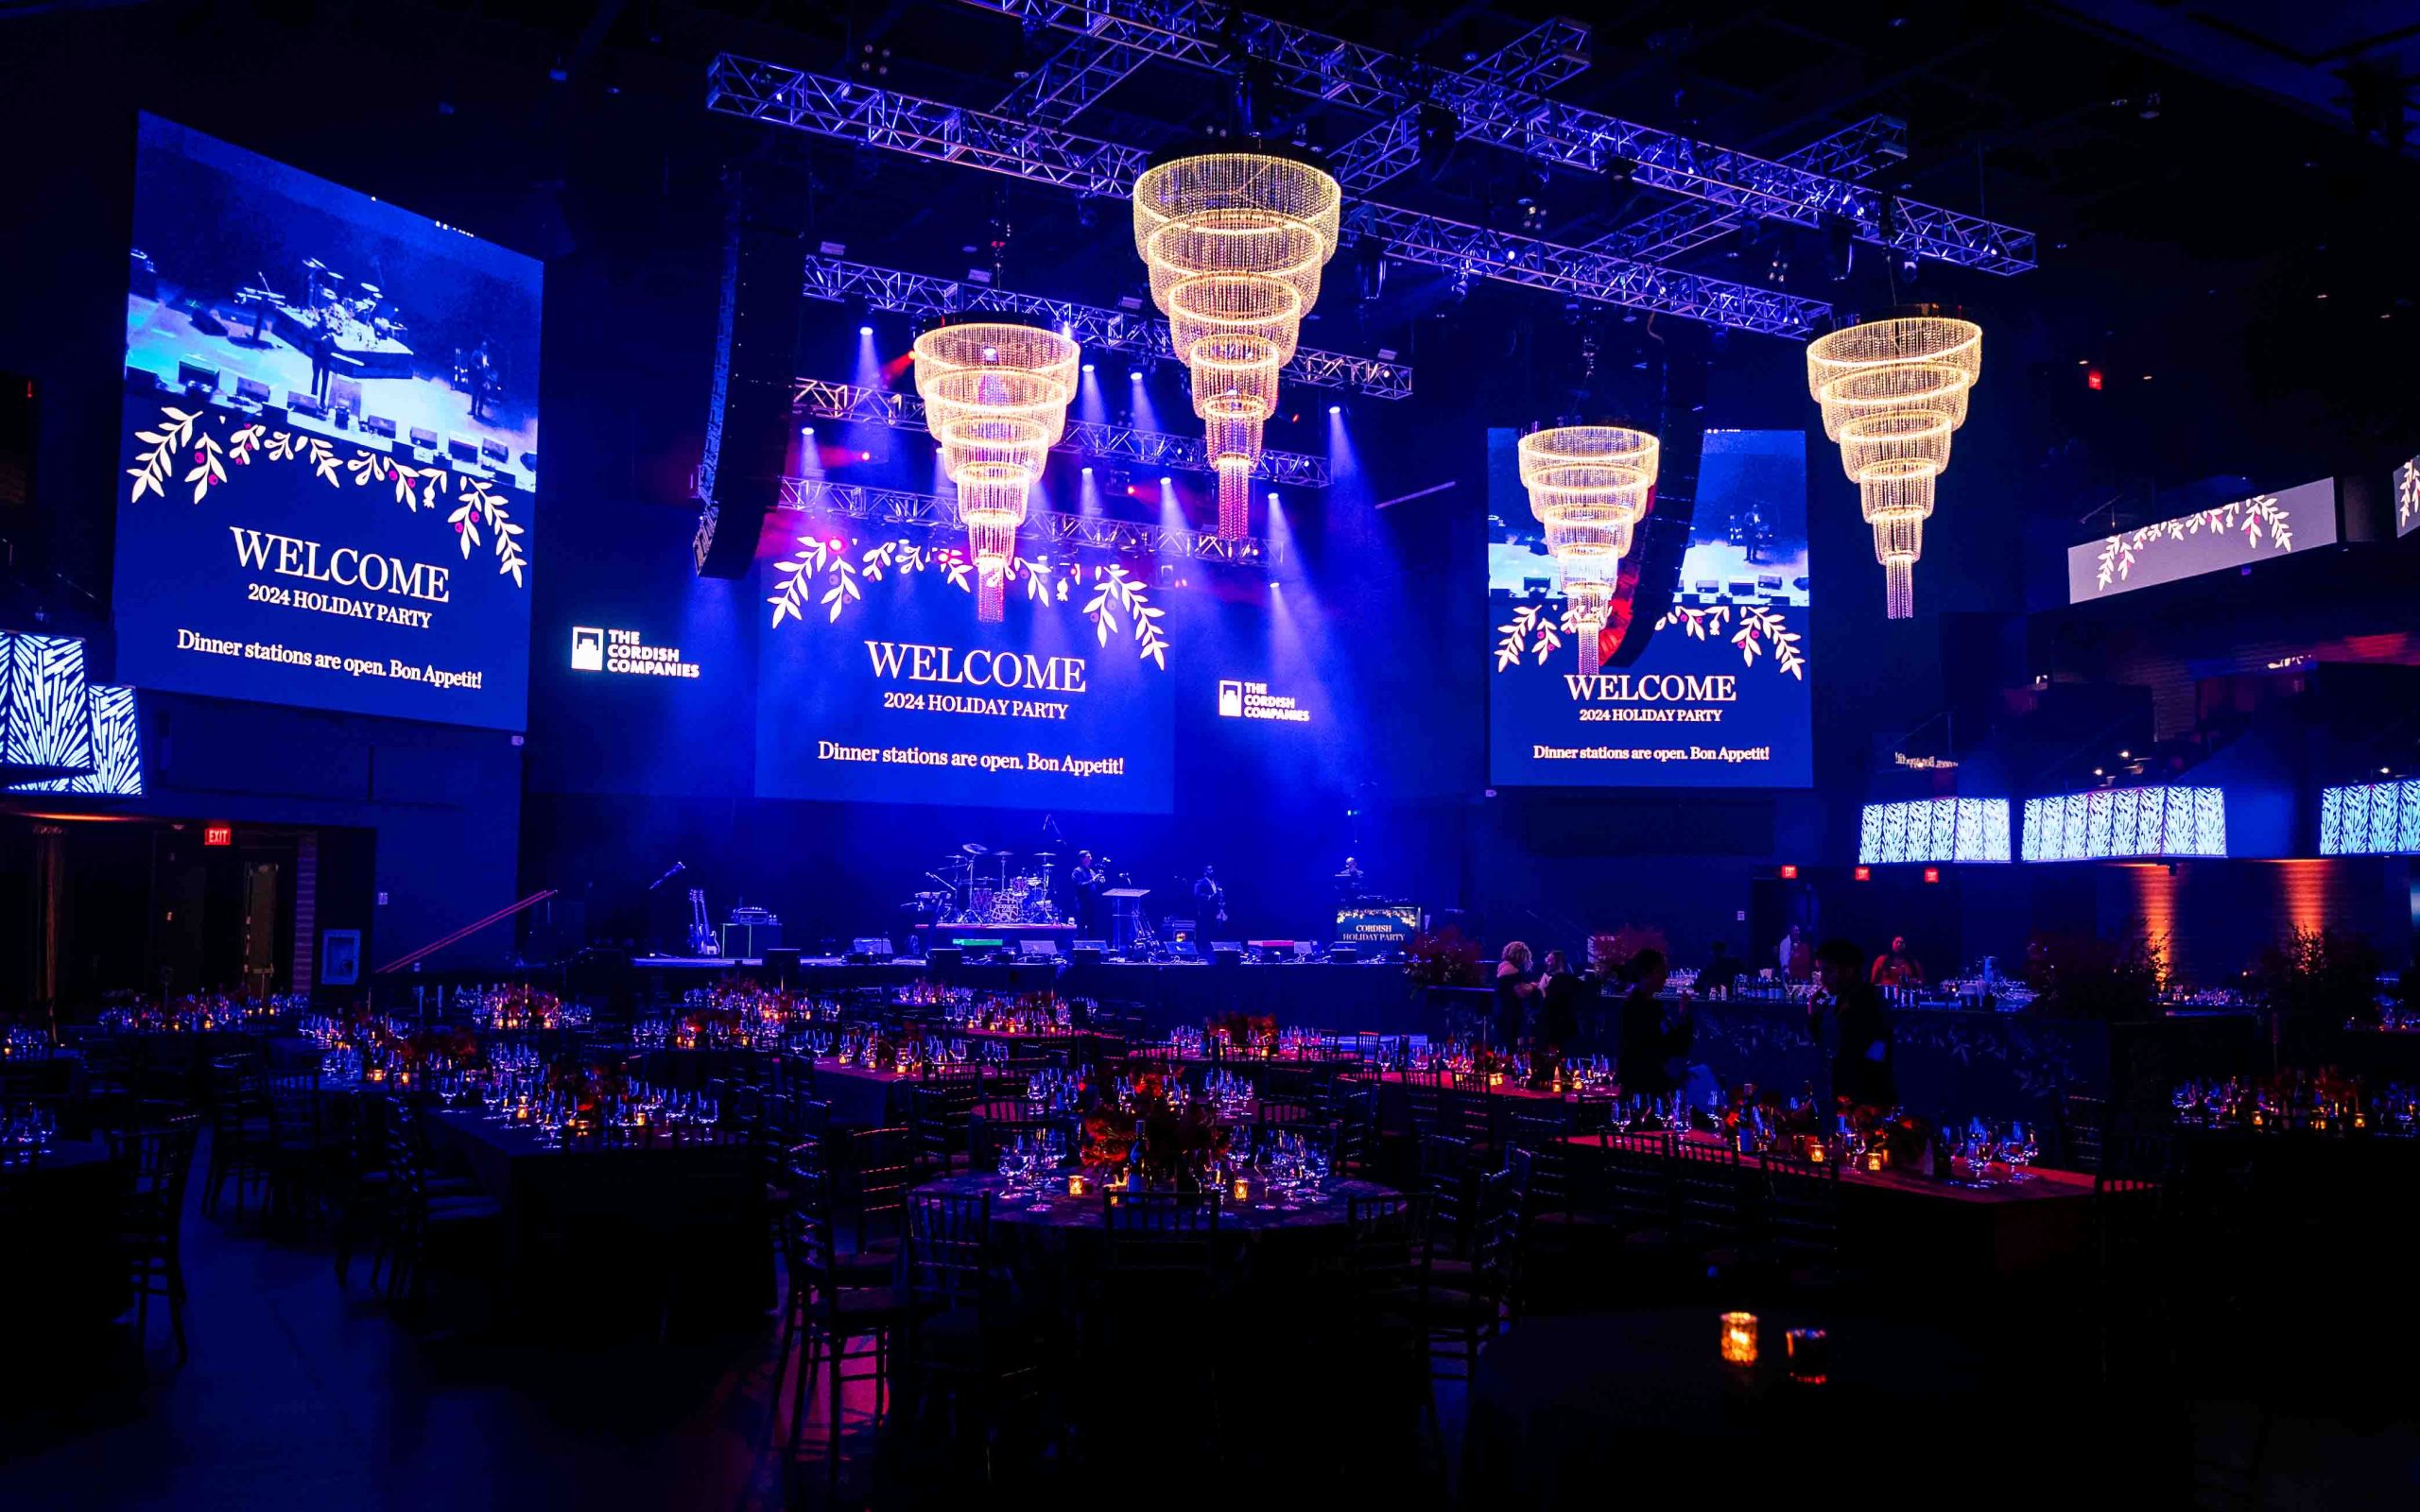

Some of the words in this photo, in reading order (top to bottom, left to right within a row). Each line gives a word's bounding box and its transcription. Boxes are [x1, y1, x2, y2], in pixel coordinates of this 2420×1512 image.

[229, 525, 450, 603] WELCOME
[248, 583, 291, 606] 2024
[293, 590, 375, 620] HOLIDAY
[375, 604, 433, 629] PARTY
[608, 628, 641, 645] THE
[177, 628, 243, 658] Dinner
[244, 642, 313, 667] stations
[314, 654, 342, 670] are
[343, 659, 388, 678] open.
[389, 659, 422, 681] Bon
[423, 663, 482, 690] Appetit!
[607, 644, 680, 663] CORDISH
[606, 658, 700, 679] COMPANIES
[863, 640, 1087, 694] WELCOME
[1243, 681, 1268, 696] THE
[1563, 674, 1737, 701] WELCOME
[883, 692, 925, 710] 2024
[927, 695, 1011, 716] HOLIDAY
[1011, 700, 1069, 720] PARTY
[1243, 694, 1296, 710] CORDISH
[1243, 705, 1311, 722] COMPANIES
[1579, 709, 1612, 722] 2024
[1612, 708, 1676, 722] HOLIDAY
[1676, 709, 1723, 722] PARTY
[818, 740, 880, 764] Dinner
[882, 747, 949, 767] stations
[950, 752, 977, 768] are
[979, 755, 1024, 772] open.
[1027, 752, 1060, 772] Bon
[1061, 754, 1125, 777] Appetit!
[1532, 745, 1579, 760] Dinner
[1579, 746, 1631, 760] stations
[1631, 749, 1652, 760] are
[1652, 749, 1688, 763] open.
[1689, 746, 1718, 760] Bon
[1718, 746, 1770, 763] Appetit!
[209, 830, 228, 844] EXIT
[1342, 933, 1379, 942] HOLIDAY
[1379, 933, 1405, 941] PARTY
[1356, 924, 1392, 933] CORDISH
